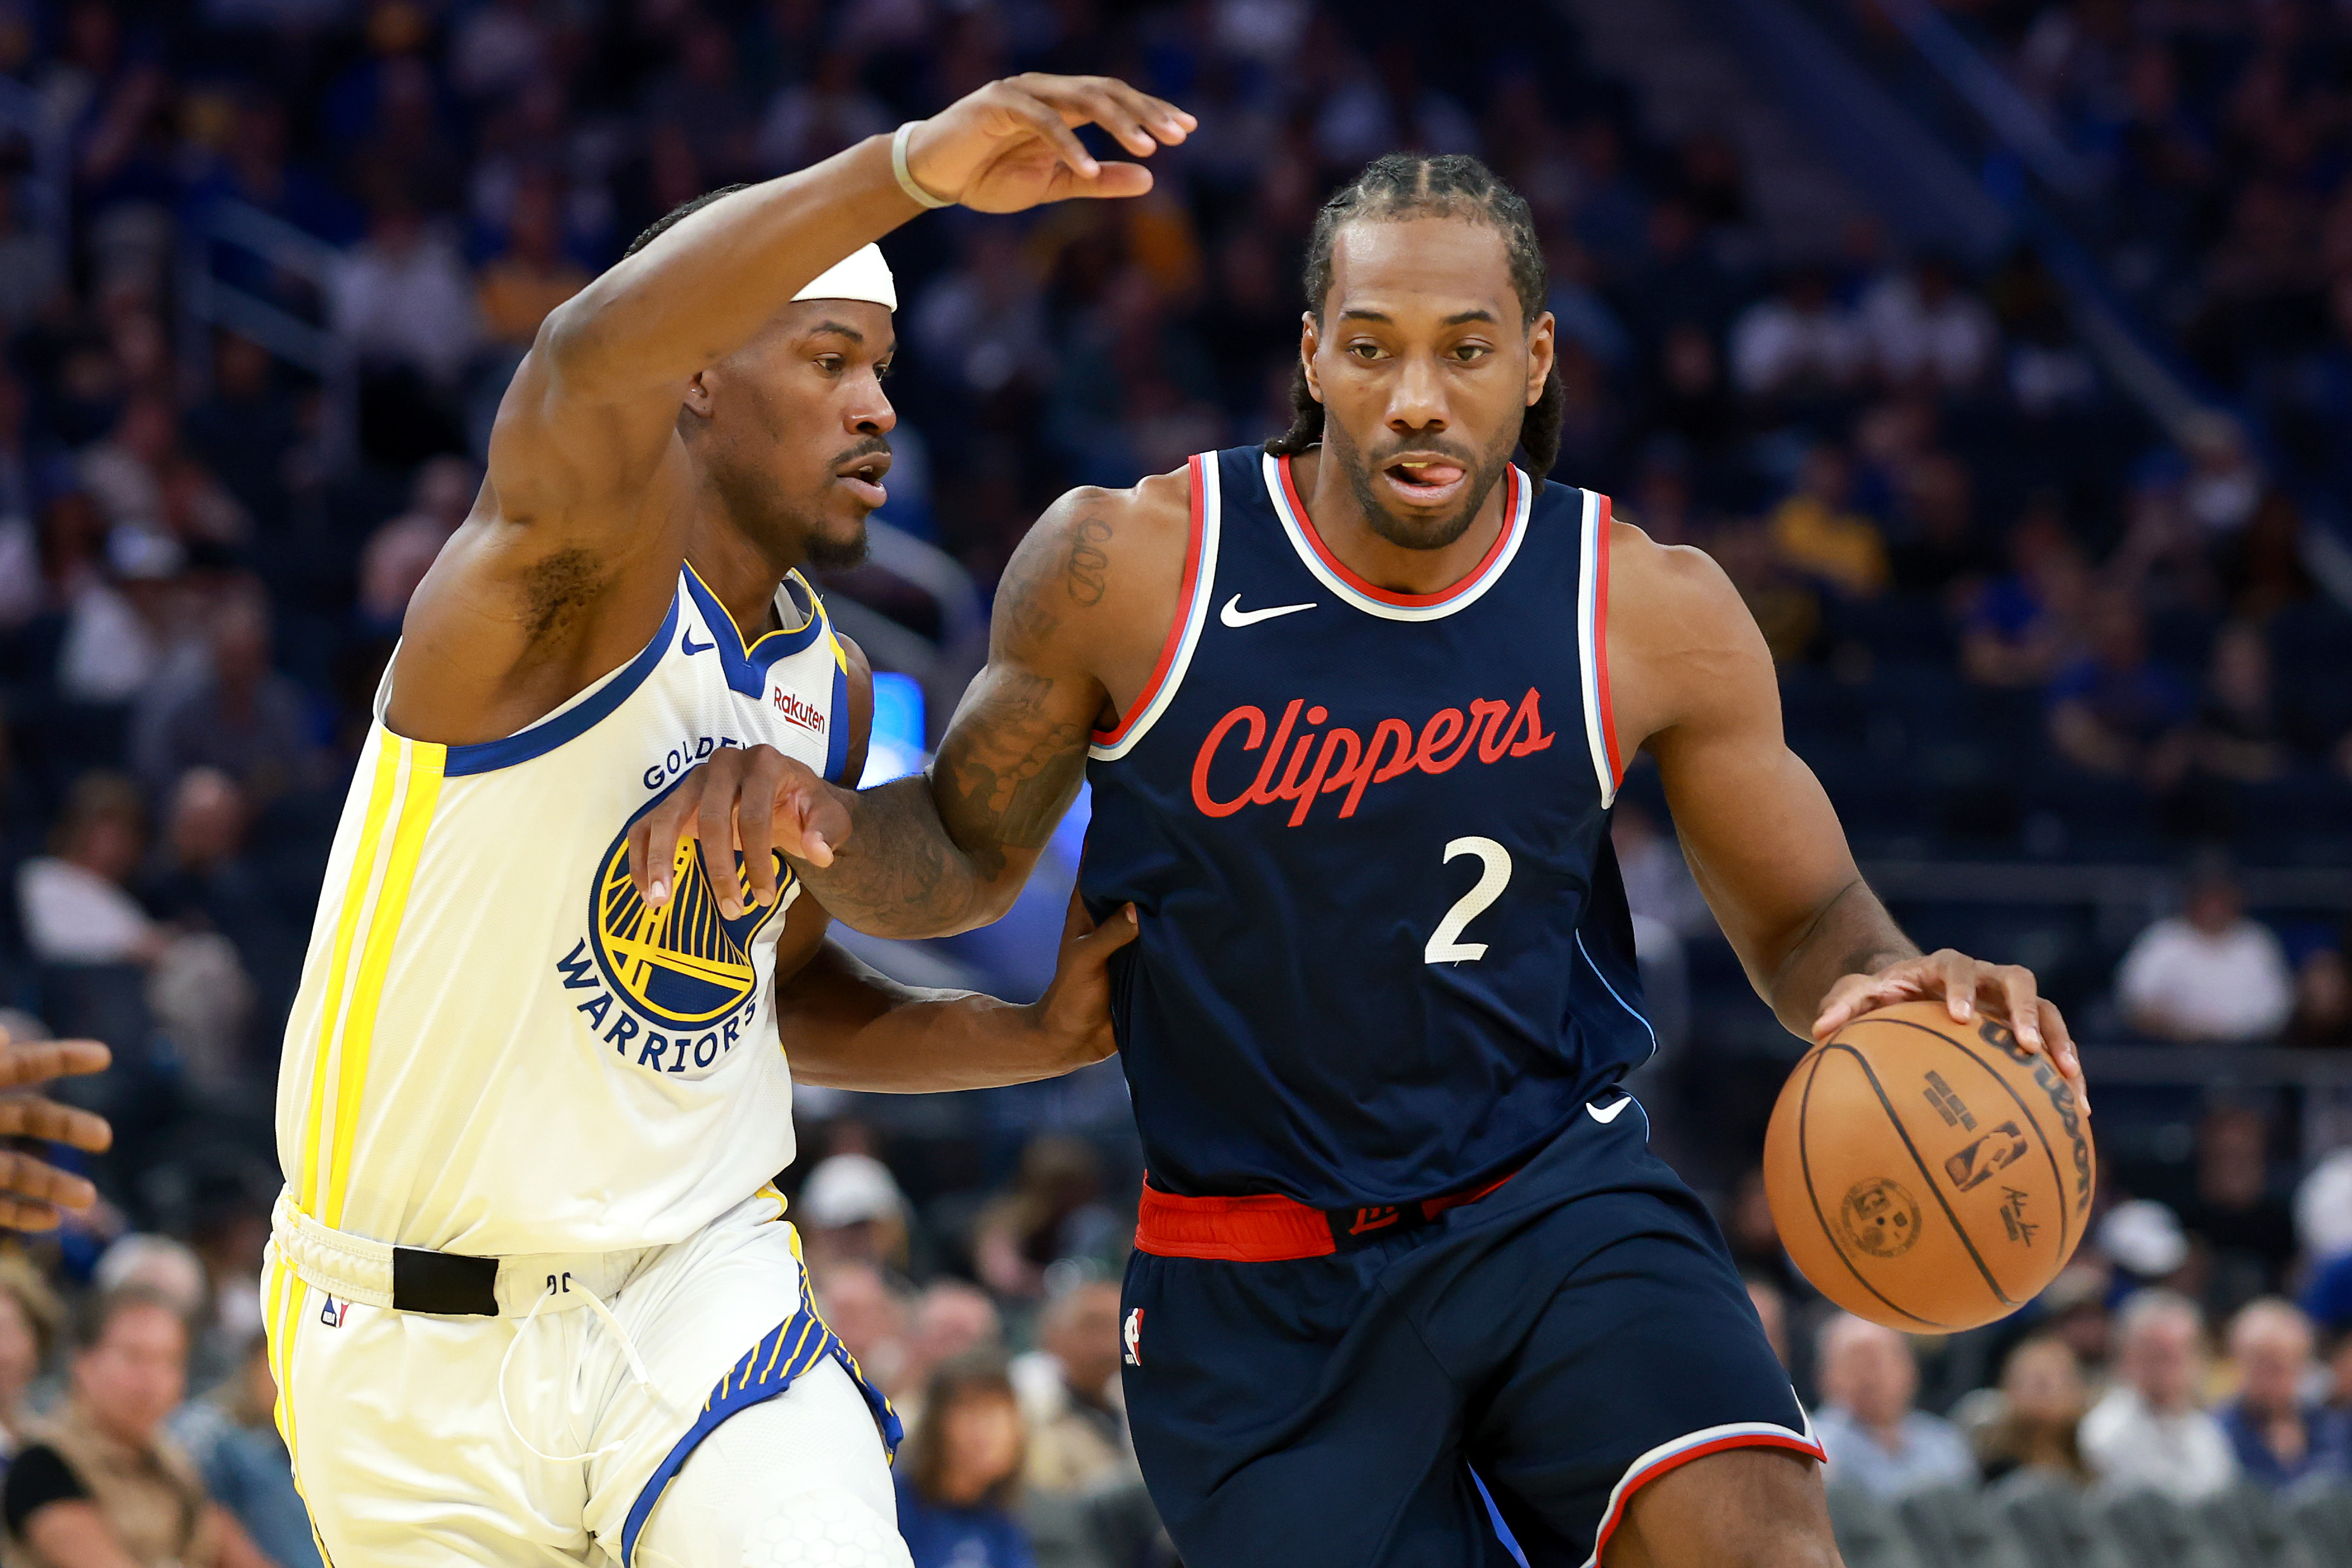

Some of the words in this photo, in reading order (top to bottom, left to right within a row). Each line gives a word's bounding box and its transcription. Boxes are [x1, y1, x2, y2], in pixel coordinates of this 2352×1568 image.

[774, 685, 825, 735] Rakuten
[643, 736, 748, 790] GOLD
[1191, 686, 1556, 827] Clippers
[1424, 835, 1512, 965] 2
[556, 936, 758, 1073] WARRIORS
[323, 1311, 335, 1324] NBA
